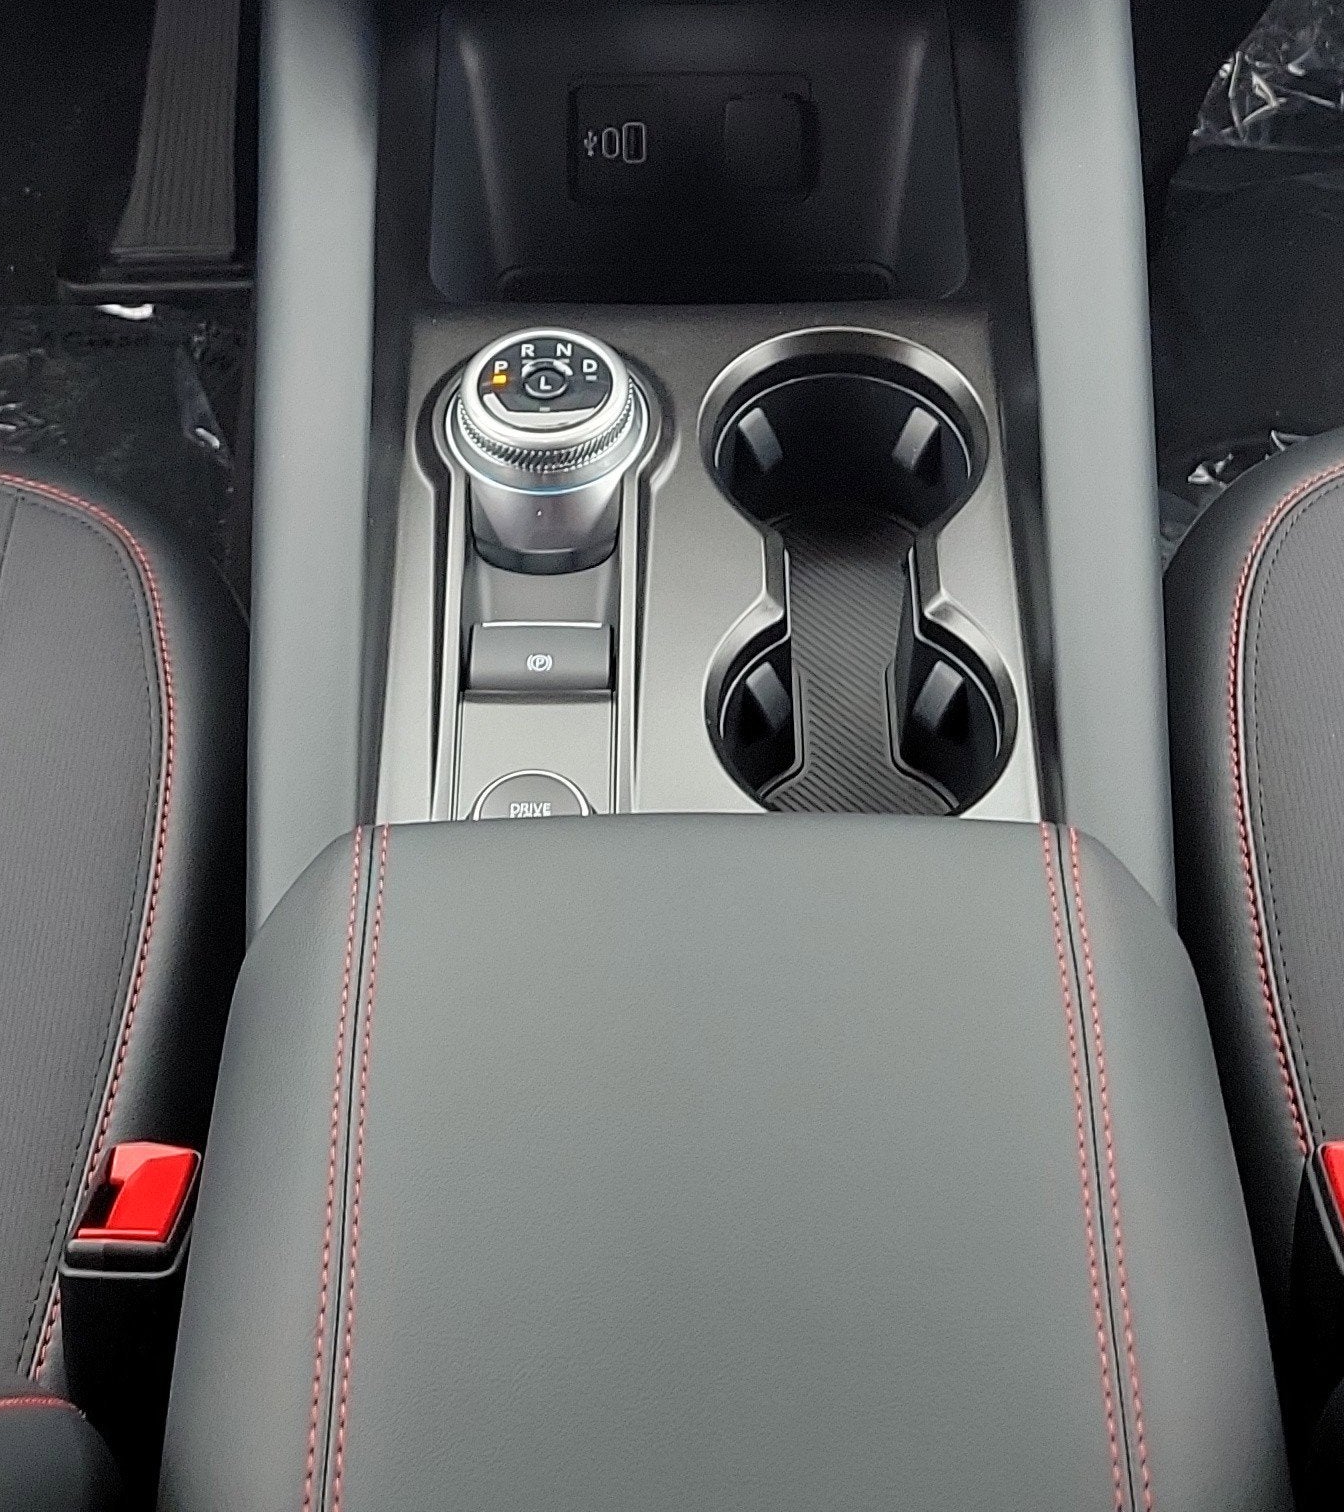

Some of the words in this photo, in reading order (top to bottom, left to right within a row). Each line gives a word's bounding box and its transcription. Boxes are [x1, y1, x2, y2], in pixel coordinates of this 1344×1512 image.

[520, 343, 536, 357] R
[556, 342, 573, 357] N
[493, 360, 509, 374] P
[582, 359, 599, 374] D
[539, 375, 552, 390] L
